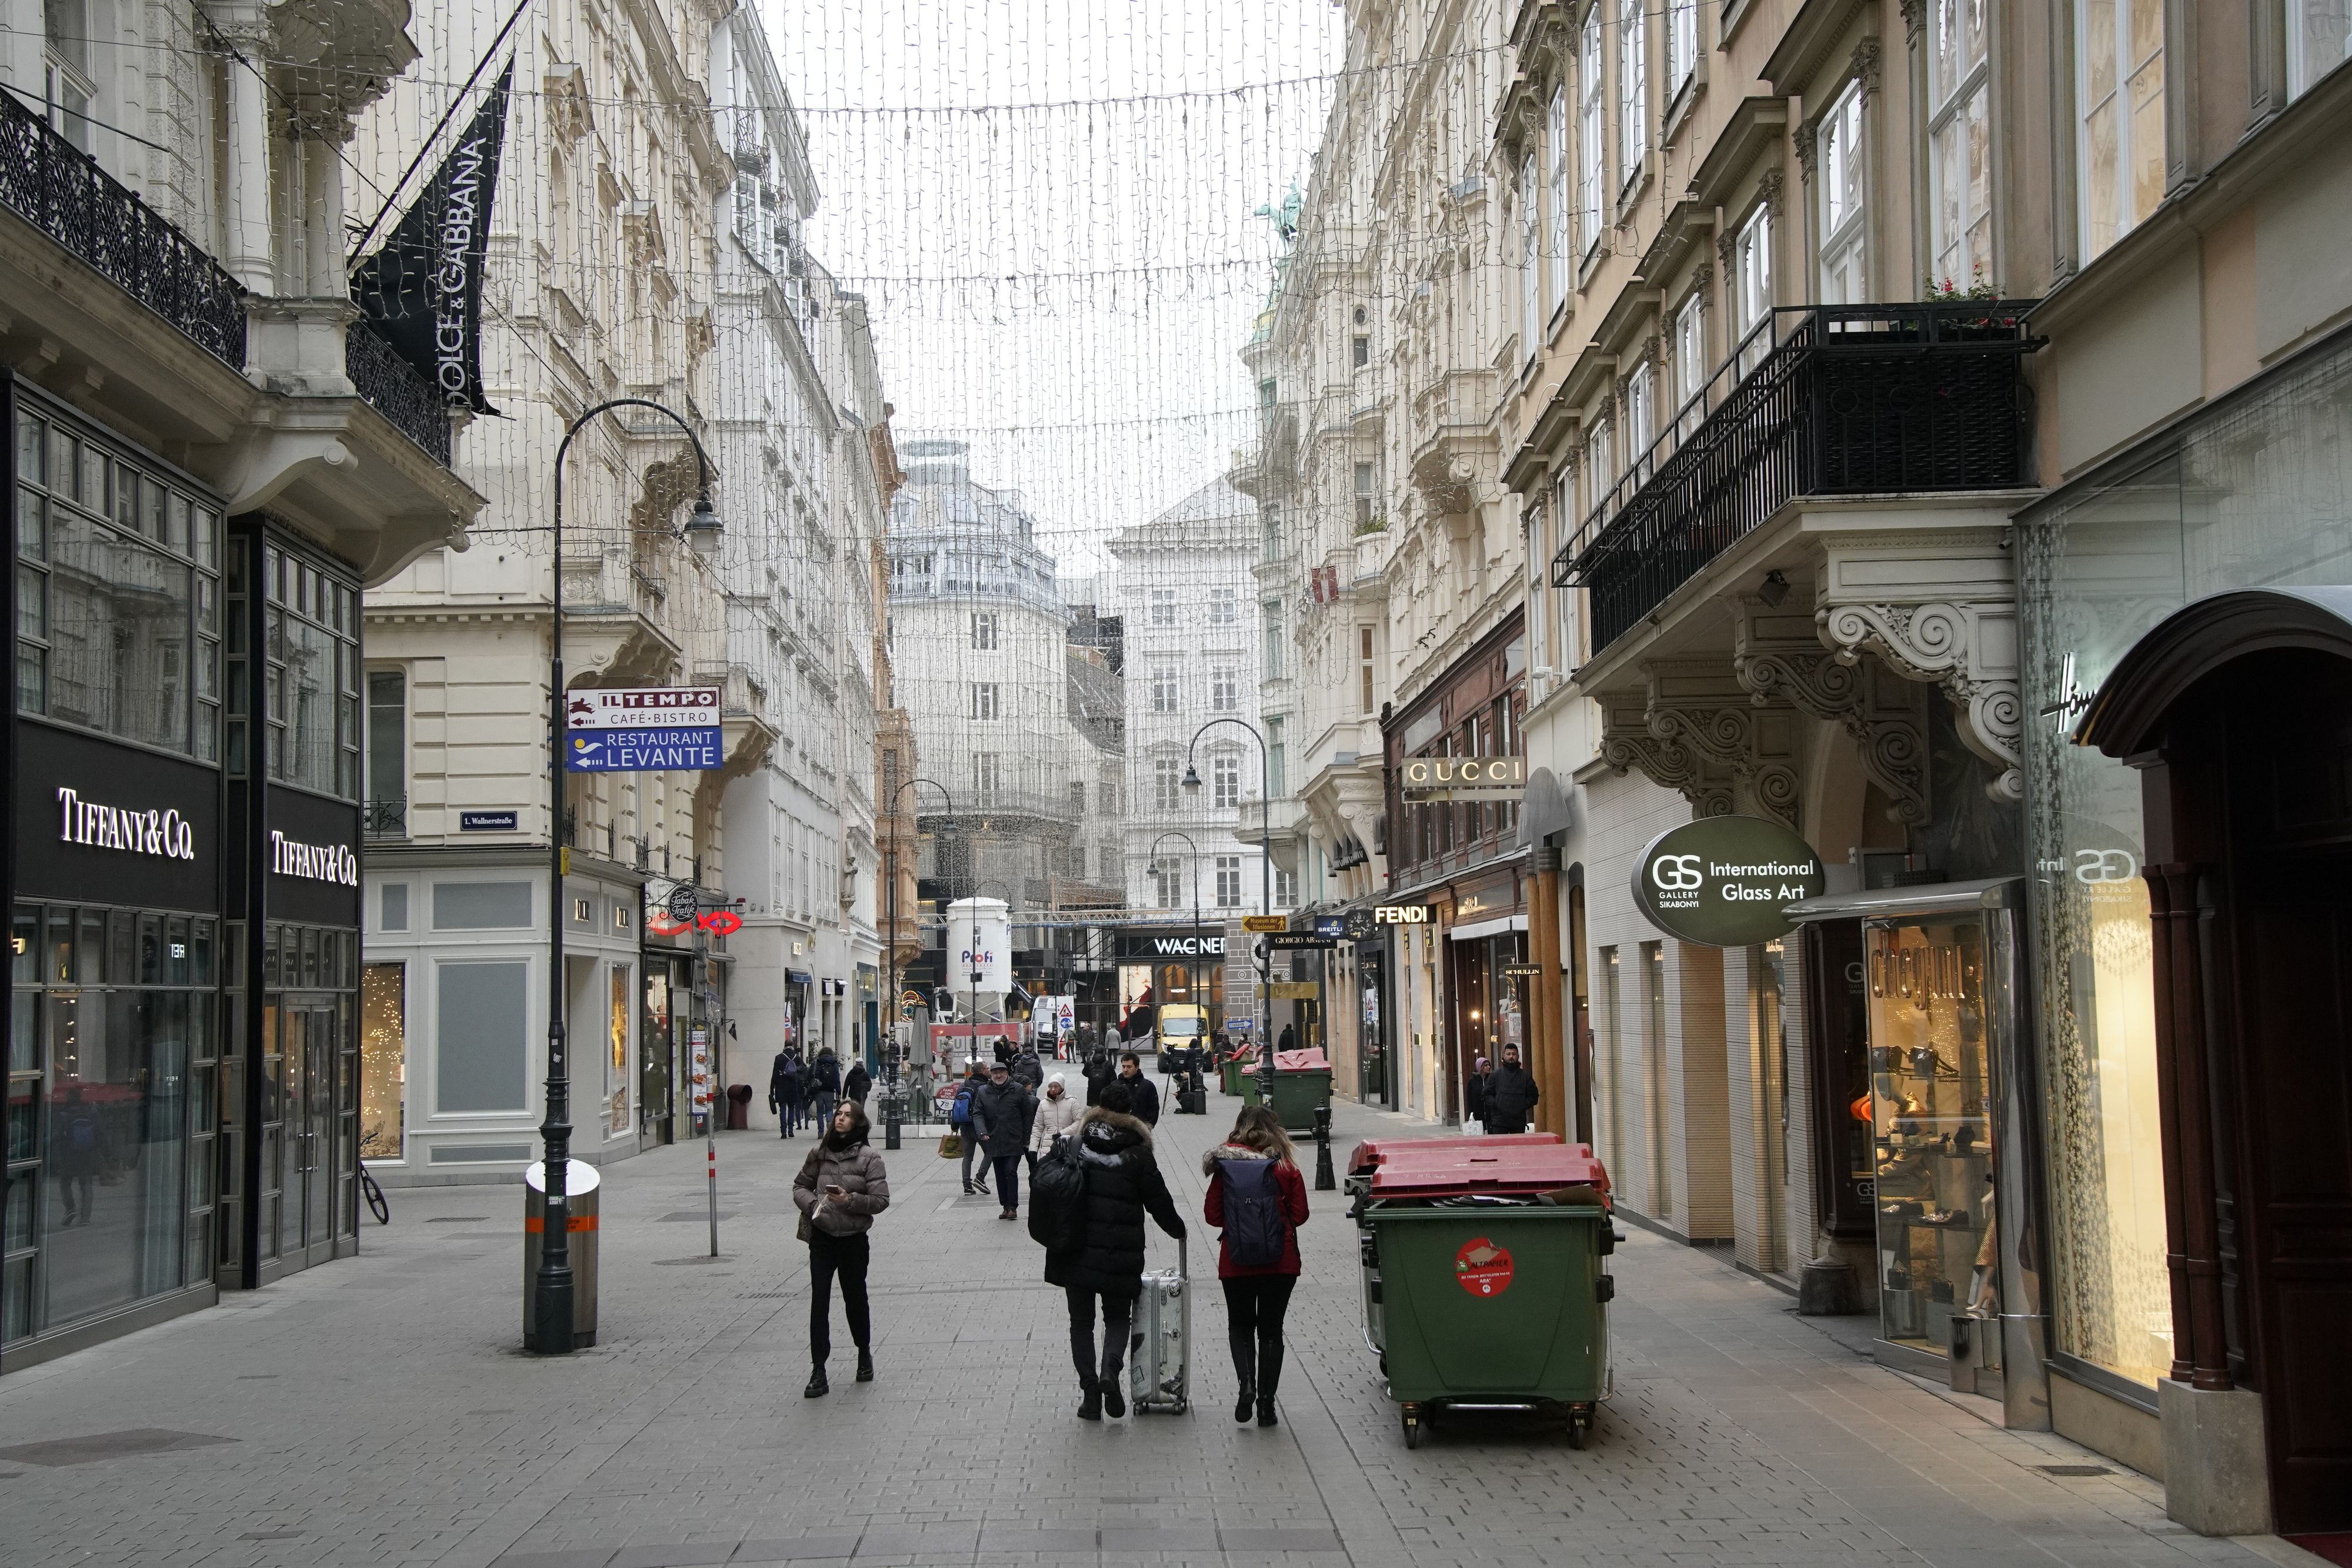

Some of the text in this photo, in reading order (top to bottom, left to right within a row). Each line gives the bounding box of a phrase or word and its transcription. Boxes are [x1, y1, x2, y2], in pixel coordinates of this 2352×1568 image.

[438, 137, 486, 293] GABBANA
[450, 297, 464, 309] &
[607, 732, 713, 746] RESTAURANT
[607, 747, 714, 767] LEVANTE
[1409, 762, 1519, 781] GUCCI
[1652, 854, 1814, 890] GS International
[671, 891, 696, 905] Tabak
[1722, 883, 1772, 901] Glass
[1778, 883, 1805, 900] Art
[671, 906, 696, 918] Trafik
[1375, 906, 1427, 923] FENDI
[1470, 1259, 1508, 1269] ALTPAPIER
